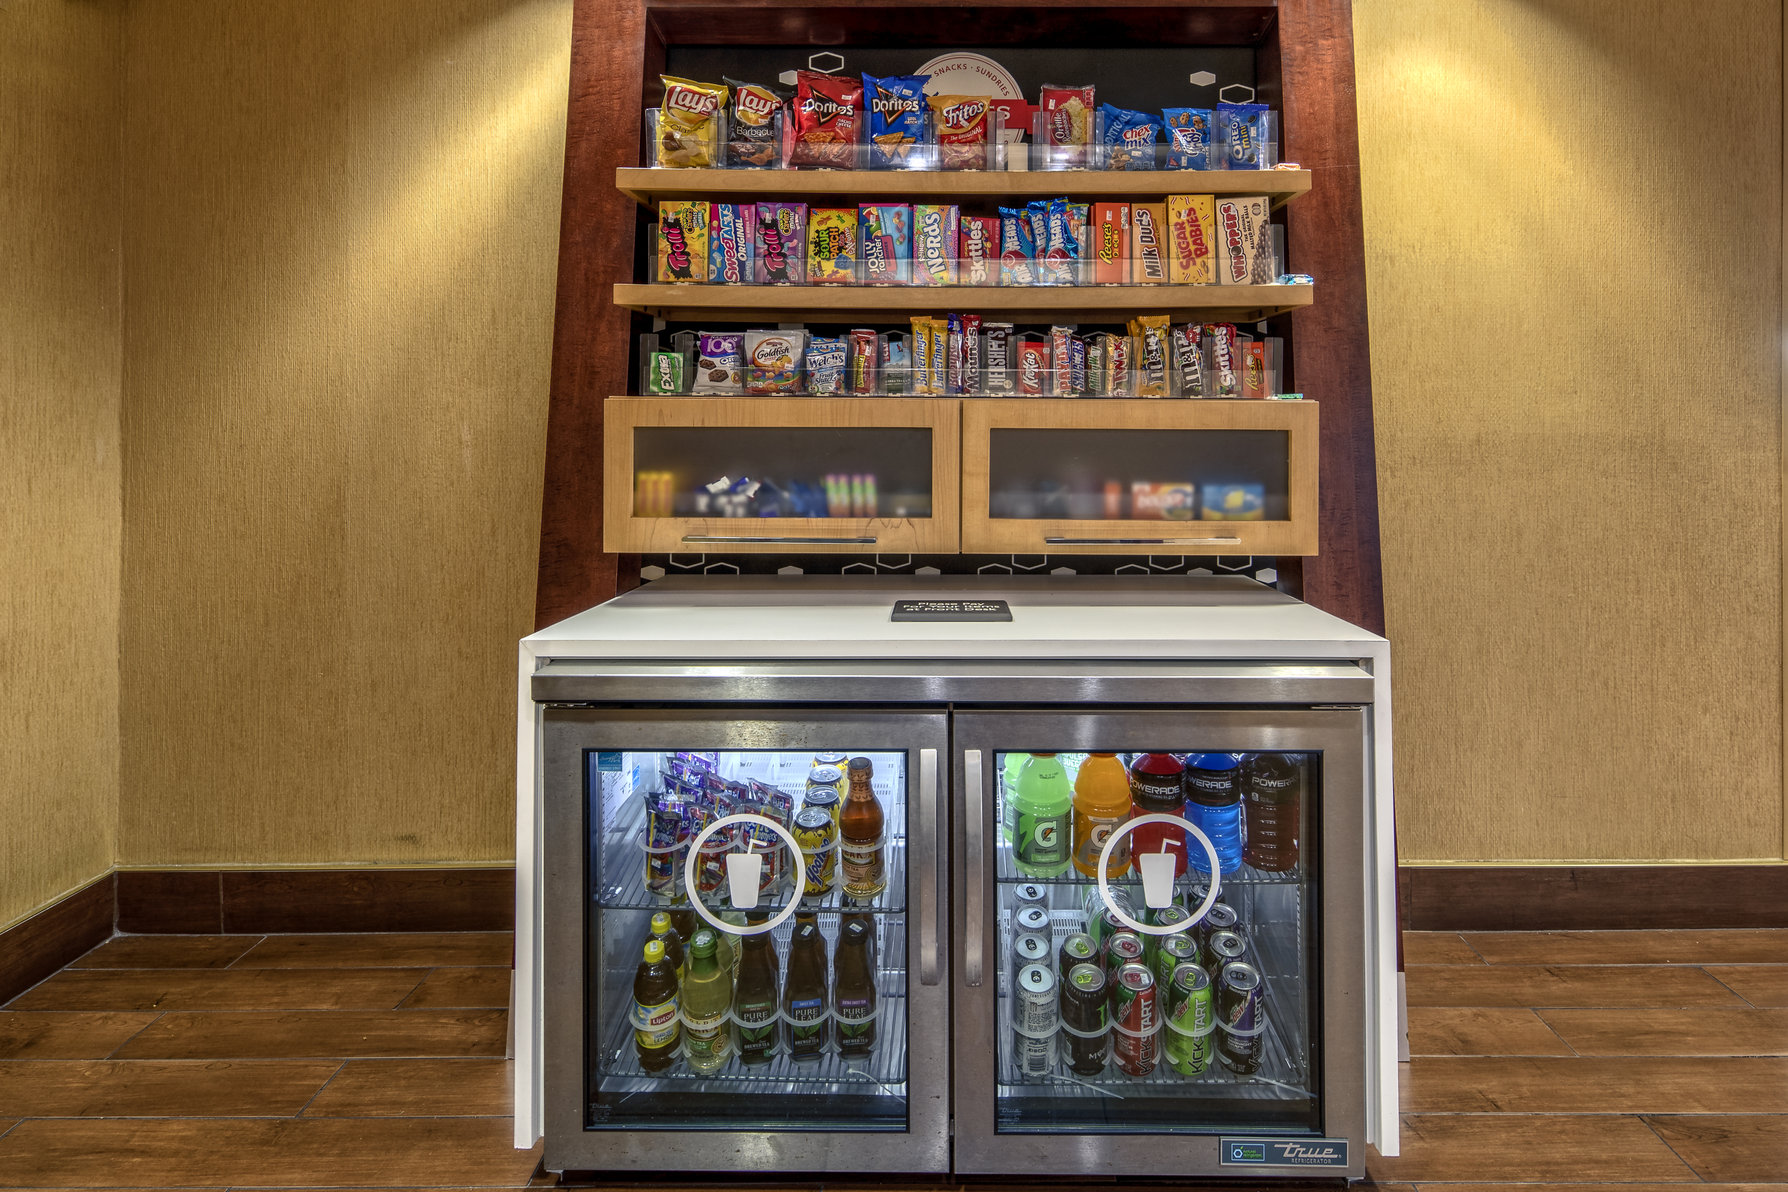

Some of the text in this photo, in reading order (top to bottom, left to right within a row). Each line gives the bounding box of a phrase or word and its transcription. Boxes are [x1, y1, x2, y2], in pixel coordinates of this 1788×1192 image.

[933, 63, 1010, 97] SNACKS SUNDRIES
[669, 86, 717, 116] Lay's
[803, 98, 854, 116] Doritos
[872, 98, 920, 114] Doritos
[943, 100, 984, 128] Fritos
[736, 126, 775, 136] Barbecue
[1122, 123, 1152, 140] Chex
[1124, 136, 1152, 150] mix
[1231, 121, 1243, 160] OREO
[1239, 125, 1251, 150] mini
[820, 230, 830, 259] SOUR
[830, 227, 840, 260] PATCH
[1175, 220, 1196, 271] SUGAR
[1187, 207, 1209, 259] BABIES
[662, 226, 691, 272] Trolli
[758, 227, 785, 272] Trolli
[865, 241, 878, 273] JOLLY
[1141, 246, 1164, 279] Milk
[757, 346, 790, 359] Goldfish
[808, 353, 844, 367] Welch's
[915, 329, 928, 387] Butterfinger
[931, 332, 945, 389] Butterfinger
[987, 329, 1006, 386] HERSHEY'S
[1215, 326, 1236, 387] Skittles
[819, 372, 835, 380] Fruit
[1129, 777, 1180, 795] POWERADE
[1187, 778, 1233, 789] WERADE
[1034, 820, 1057, 848] G
[652, 1011, 675, 1025] Lipton
[743, 1011, 769, 1020] PURE
[795, 1008, 818, 1016] PURE
[843, 1007, 867, 1016] PURE
